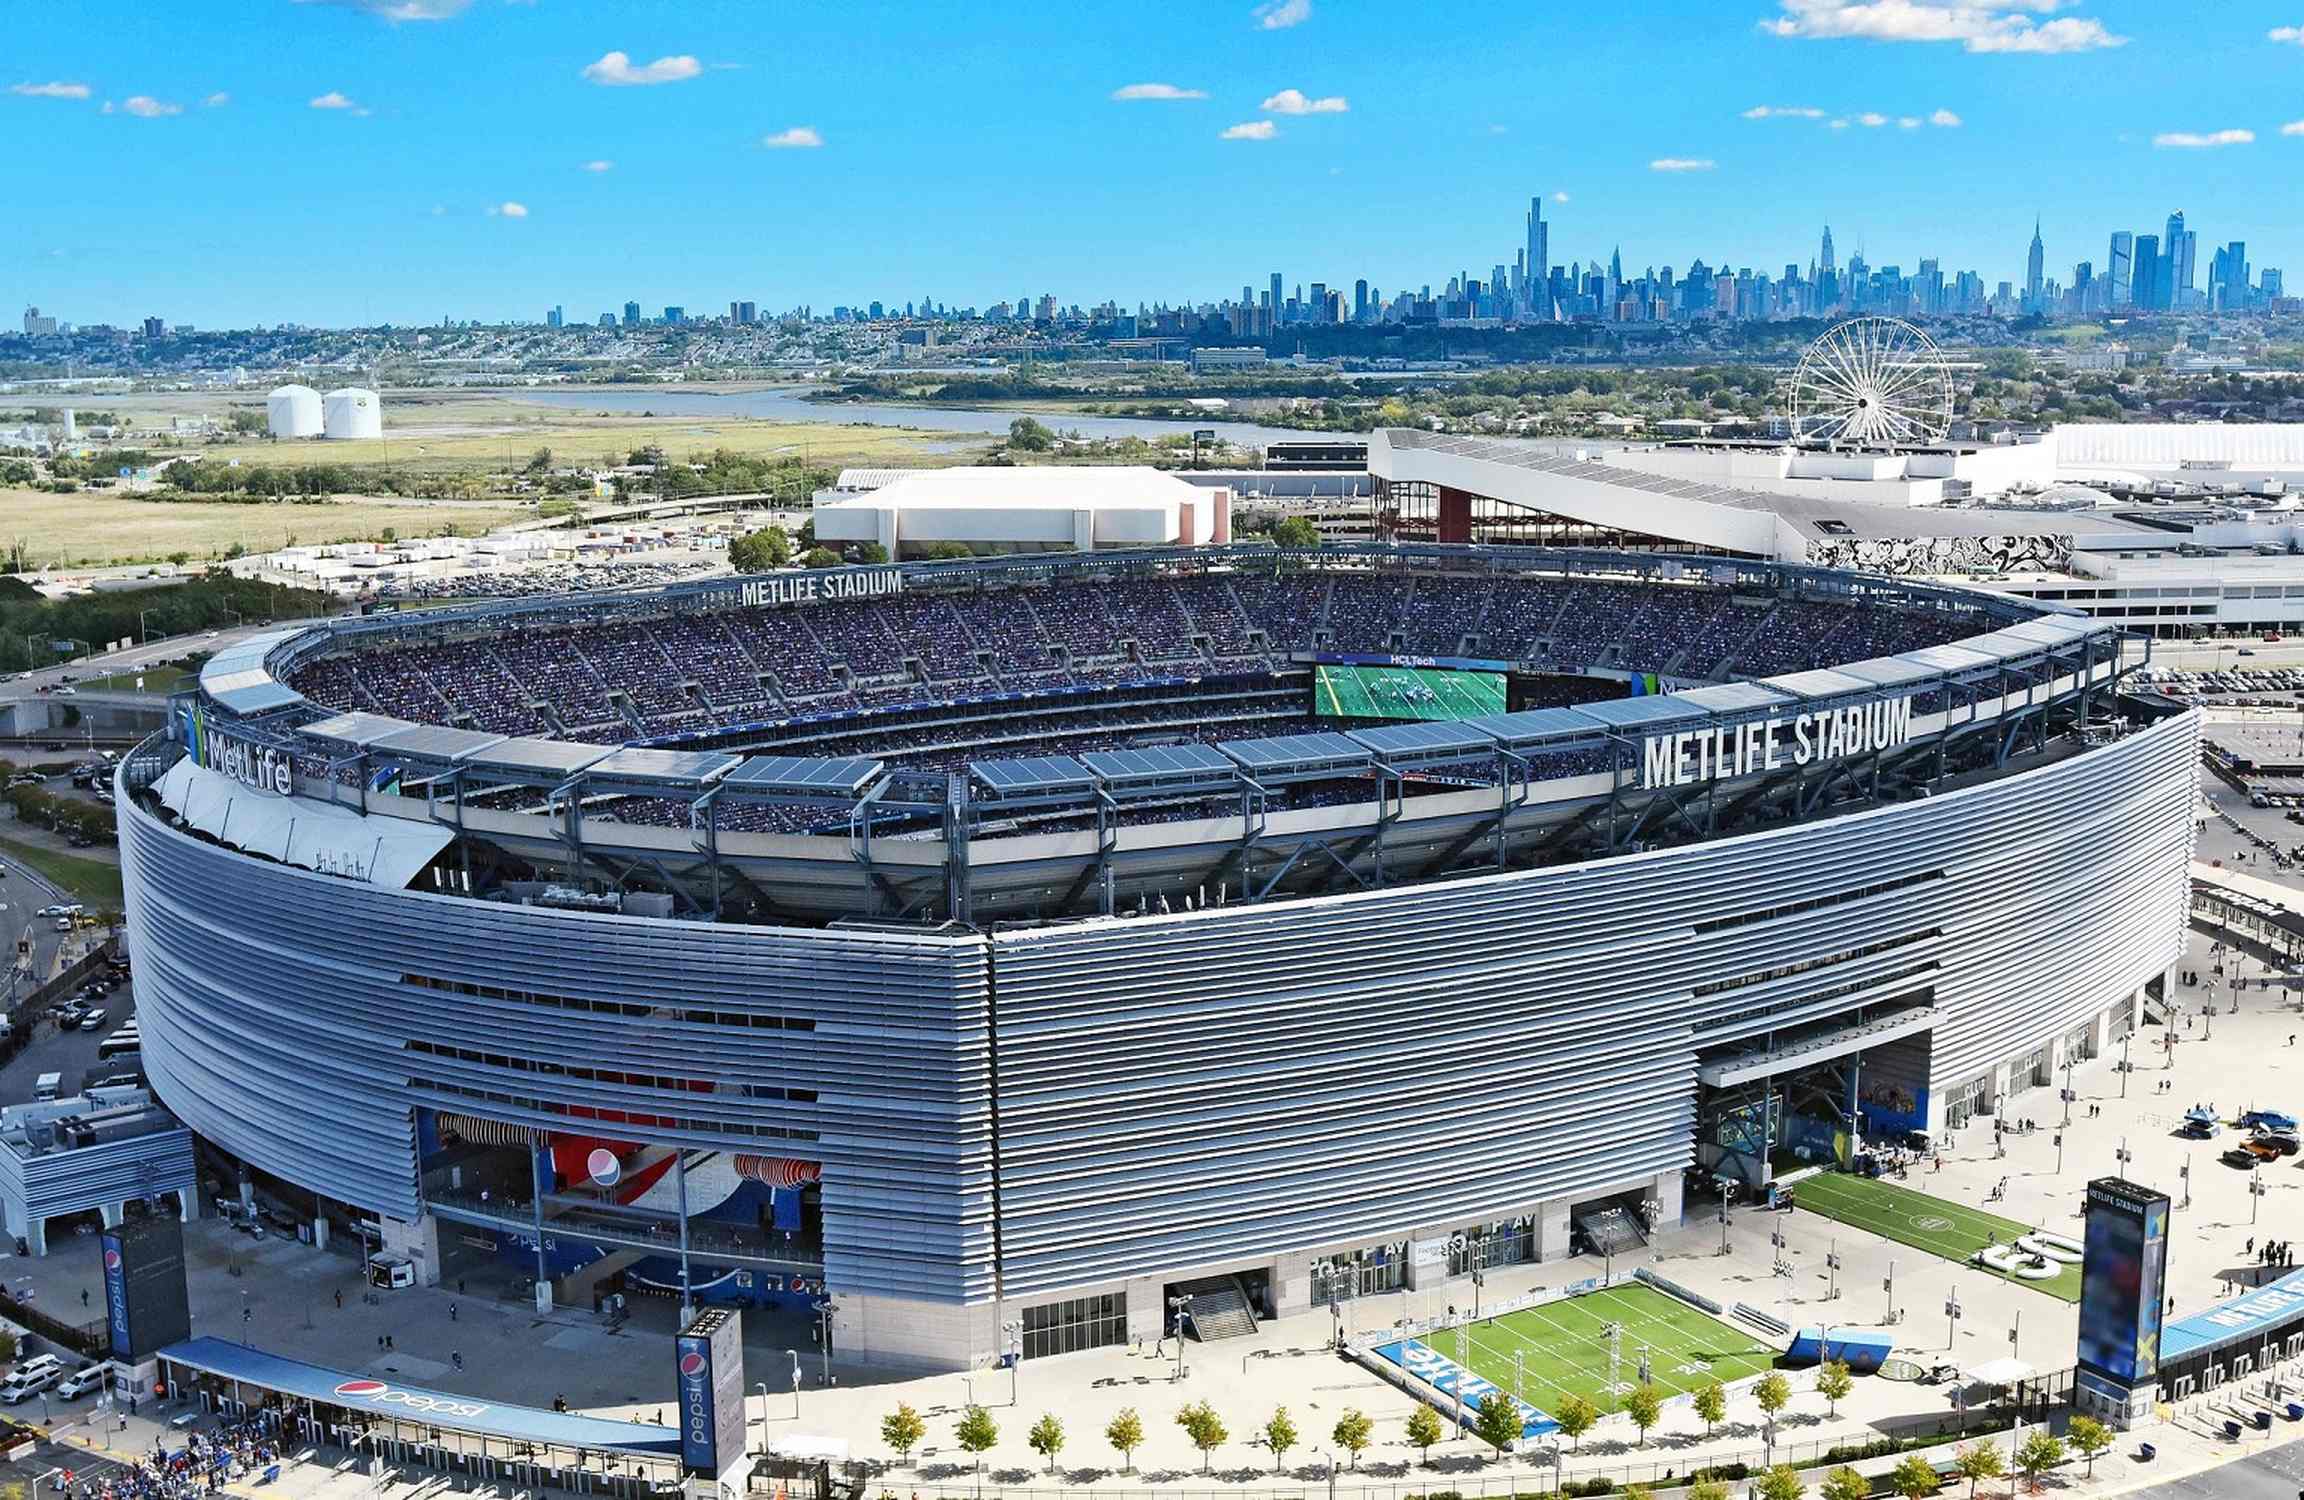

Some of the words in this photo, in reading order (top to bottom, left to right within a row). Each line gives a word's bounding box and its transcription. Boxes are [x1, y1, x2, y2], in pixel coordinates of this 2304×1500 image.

[742, 577, 818, 606] METLIFE
[823, 570, 902, 598] STADIUM
[1390, 655, 1436, 667] HCLTech
[208, 729, 292, 795] MetLife
[1644, 719, 1782, 790] METLIFE
[1794, 696, 1911, 766] STADIUM
[110, 1279, 128, 1333] pepsi
[370, 1391, 490, 1417] pepsi
[686, 1386, 709, 1444] pepsi
